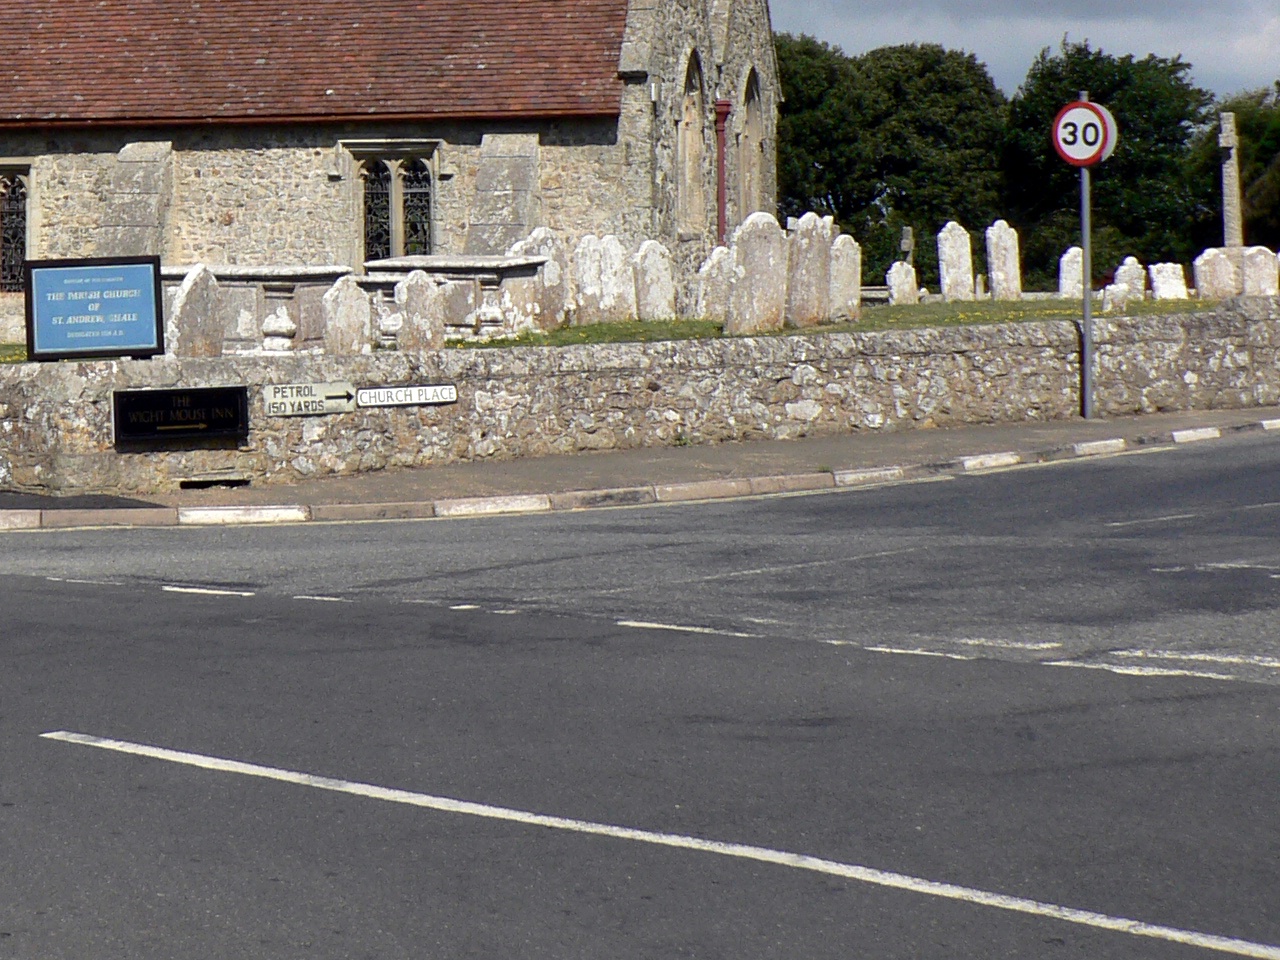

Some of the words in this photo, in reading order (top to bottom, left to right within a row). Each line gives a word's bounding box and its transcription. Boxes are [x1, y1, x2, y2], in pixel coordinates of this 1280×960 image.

[1061, 121, 1099, 146] 30
[47, 293, 64, 301] THE
[68, 291, 100, 300] PARISH
[103, 289, 140, 299] CHURCH
[88, 303, 100, 311] OF
[272, 385, 317, 399] PETROL
[359, 389, 413, 404] CHURCH
[417, 387, 455, 401] PLACE
[171, 396, 191, 408] THE
[268, 402, 287, 414] 150
[290, 400, 325, 413] YARDS
[128, 411, 165, 424] WIGHT
[169, 408, 207, 422] MOUSE
[211, 407, 234, 420] INN
